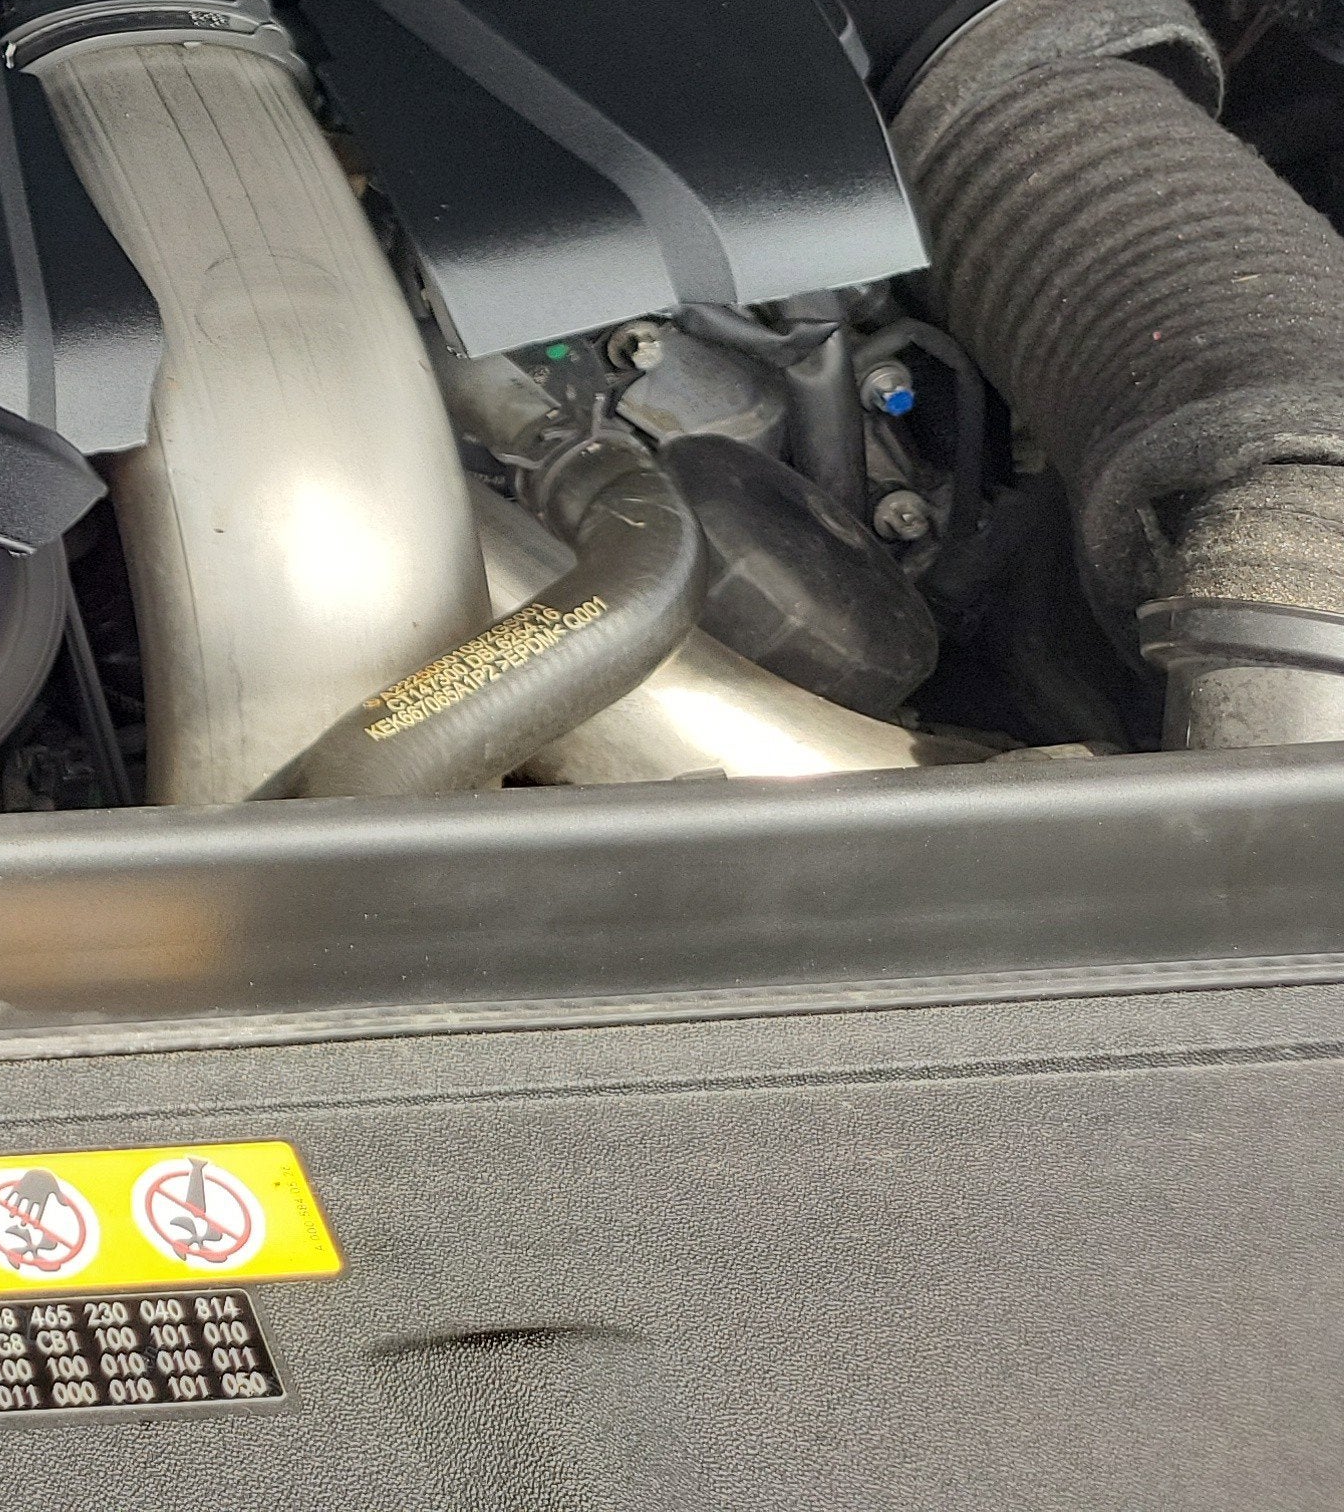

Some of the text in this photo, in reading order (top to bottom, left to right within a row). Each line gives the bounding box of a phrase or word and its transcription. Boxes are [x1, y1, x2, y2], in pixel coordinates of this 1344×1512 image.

[562, 595, 608, 630] Q001
[30, 1304, 74, 1328] 465
[83, 1301, 129, 1326] 230
[140, 1298, 185, 1324] 040
[195, 1295, 242, 1321] 814
[36, 1329, 81, 1355] CB1
[95, 1326, 139, 1352] 100
[150, 1323, 192, 1348] 101
[203, 1320, 249, 1347] 010
[46, 1354, 90, 1380] 100
[100, 1352, 146, 1378] 010
[156, 1348, 202, 1375] 010
[212, 1346, 257, 1372] 011
[52, 1380, 99, 1407] 000
[109, 1377, 154, 1403] 010
[167, 1374, 209, 1400] 101
[221, 1371, 267, 1398] 050
